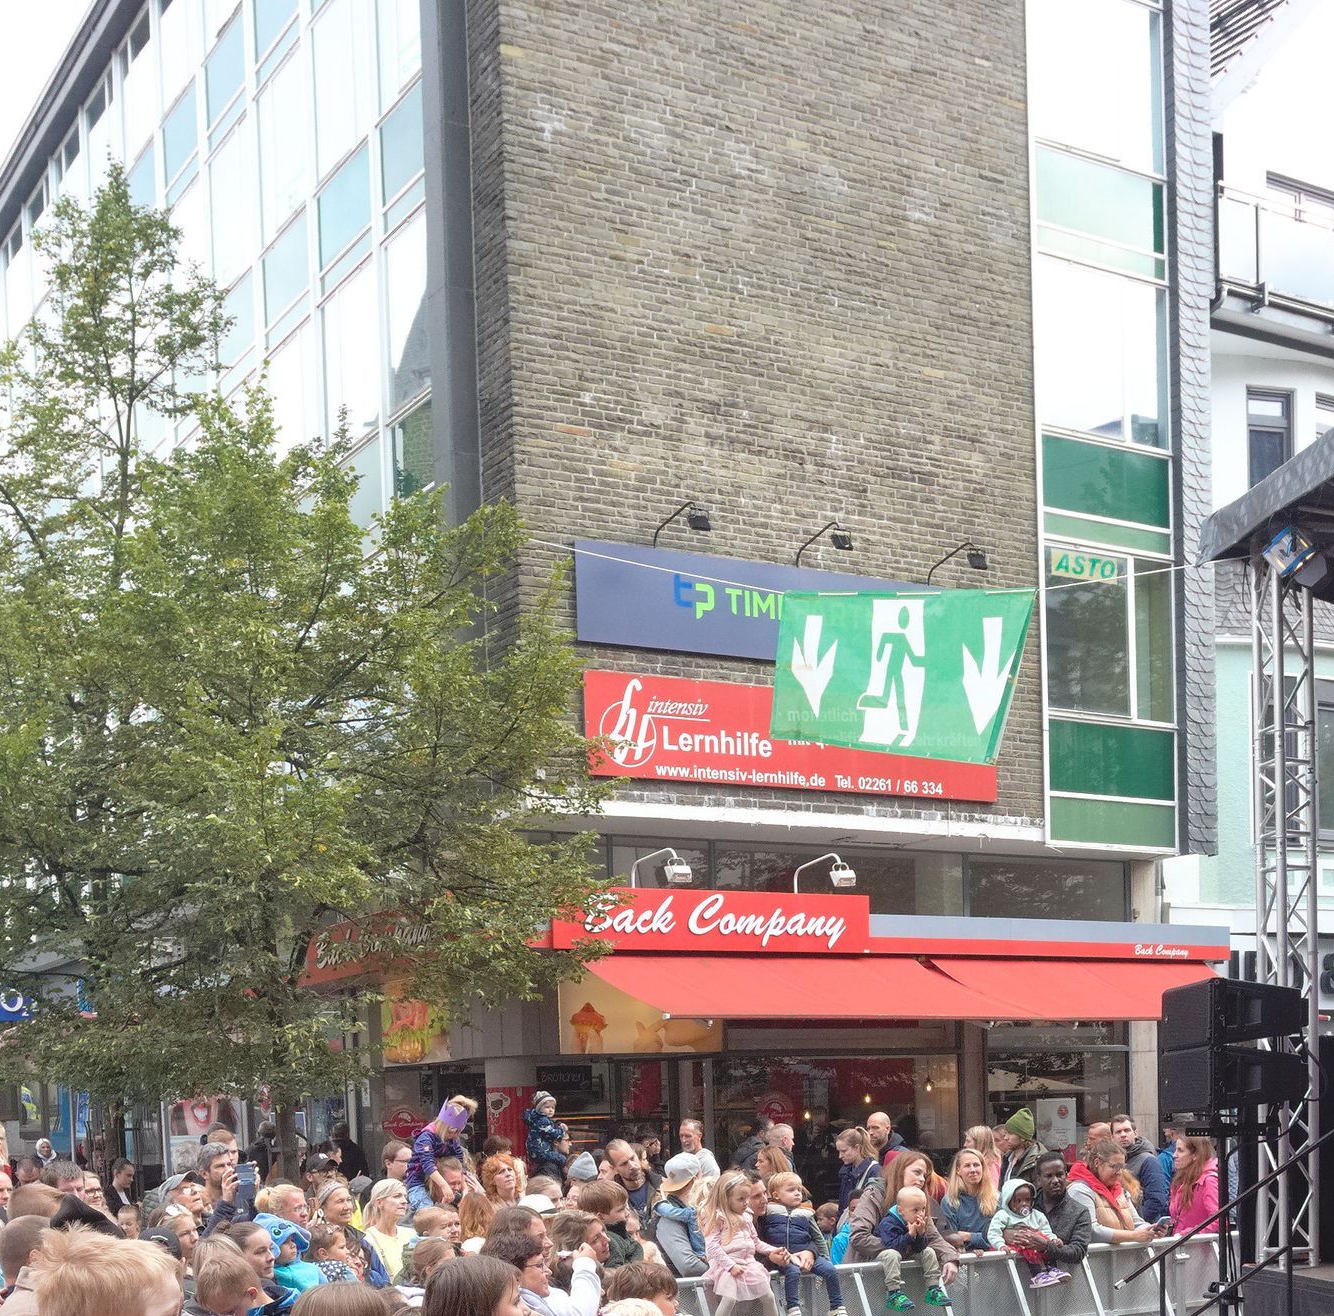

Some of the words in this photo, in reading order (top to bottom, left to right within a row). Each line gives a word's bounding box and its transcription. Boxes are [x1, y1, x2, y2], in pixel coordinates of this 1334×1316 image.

[1055, 554, 1115, 578] ASTO
[647, 696, 708, 716] intensiv
[663, 726, 772, 758] Lernhilfe
[656, 765, 826, 788] www.intensiv-lernhilfe.de
[835, 775, 854, 789] Tel.
[858, 777, 892, 791] 02261
[903, 780, 919, 793] 66
[922, 781, 943, 794] 334
[584, 893, 676, 934] Back
[688, 893, 846, 949] Company
[1134, 944, 1153, 955] Back
[1155, 944, 1189, 958] Company
